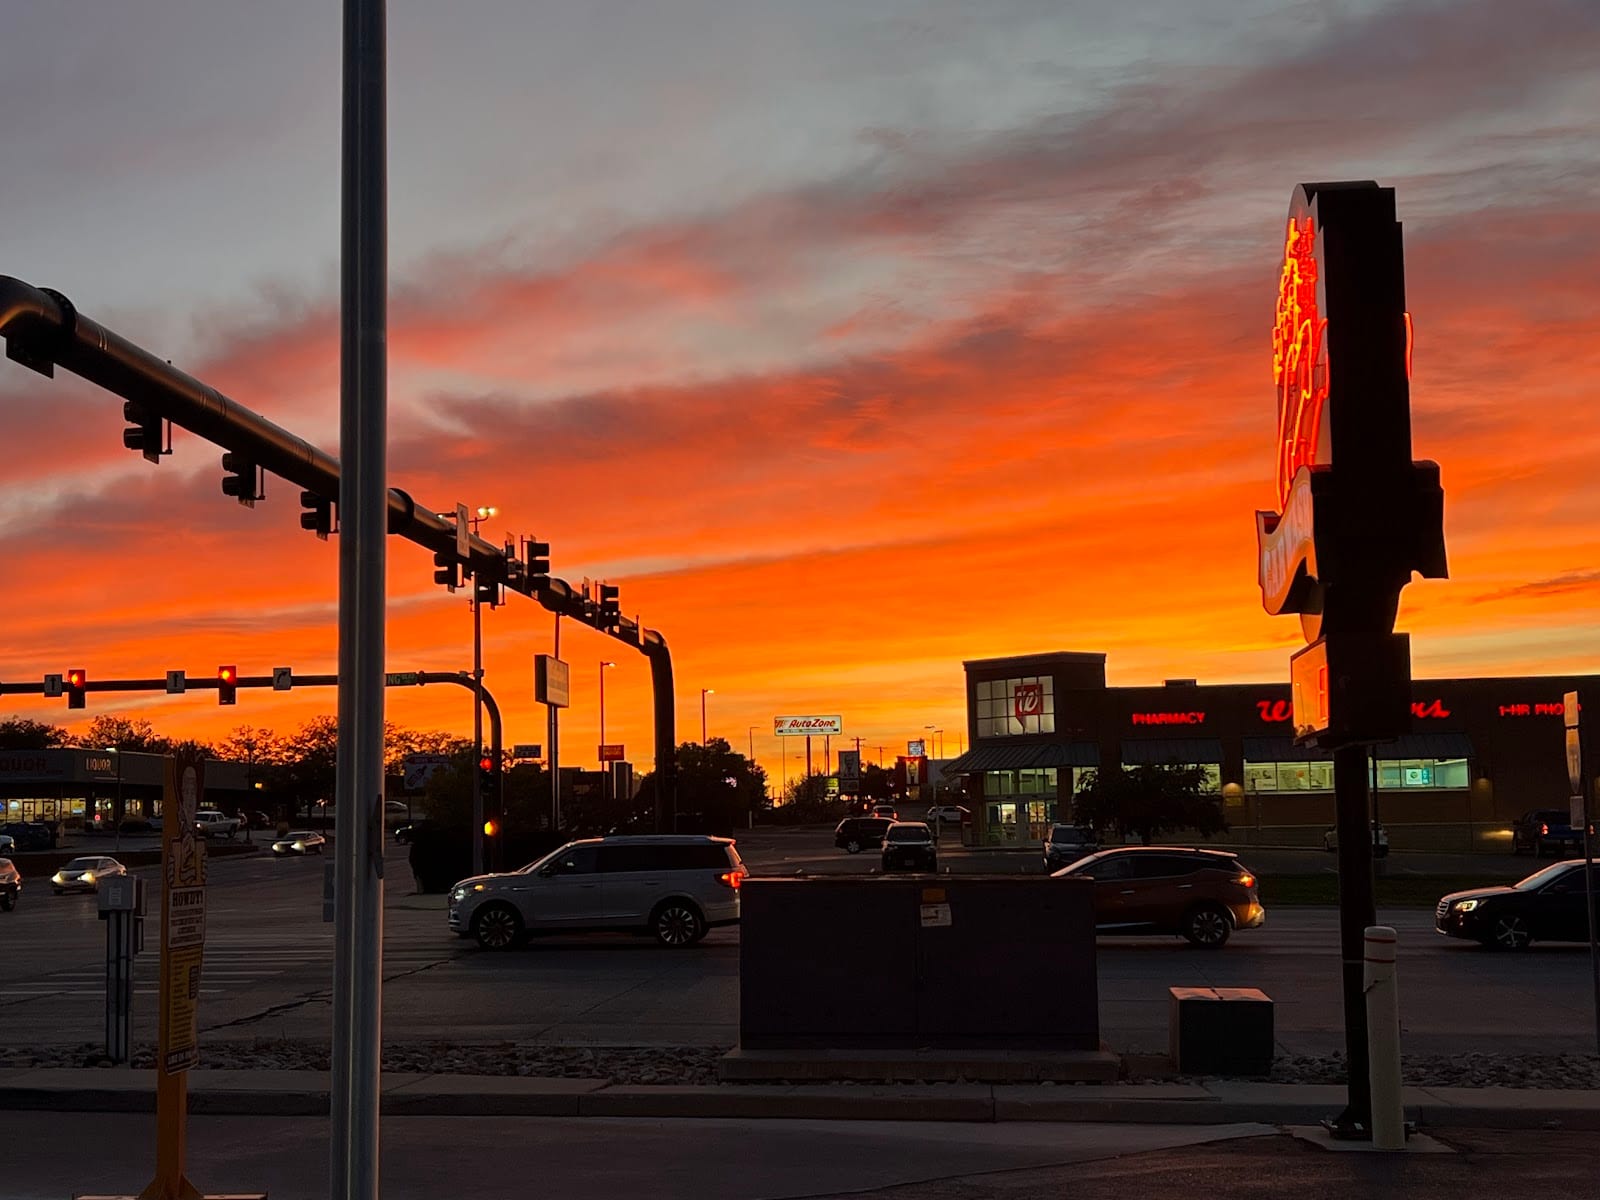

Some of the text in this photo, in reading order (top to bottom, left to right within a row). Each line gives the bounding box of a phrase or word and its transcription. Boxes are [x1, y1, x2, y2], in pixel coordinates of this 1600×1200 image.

[387, 674, 401, 685] NG
[1498, 703, 1582, 717] 1-HR PHO
[789, 718, 836, 728] AutoZone
[1132, 711, 1206, 725] PHARMACY
[85, 757, 112, 772] LIQUOR
[172, 890, 203, 907] HOWDY!
